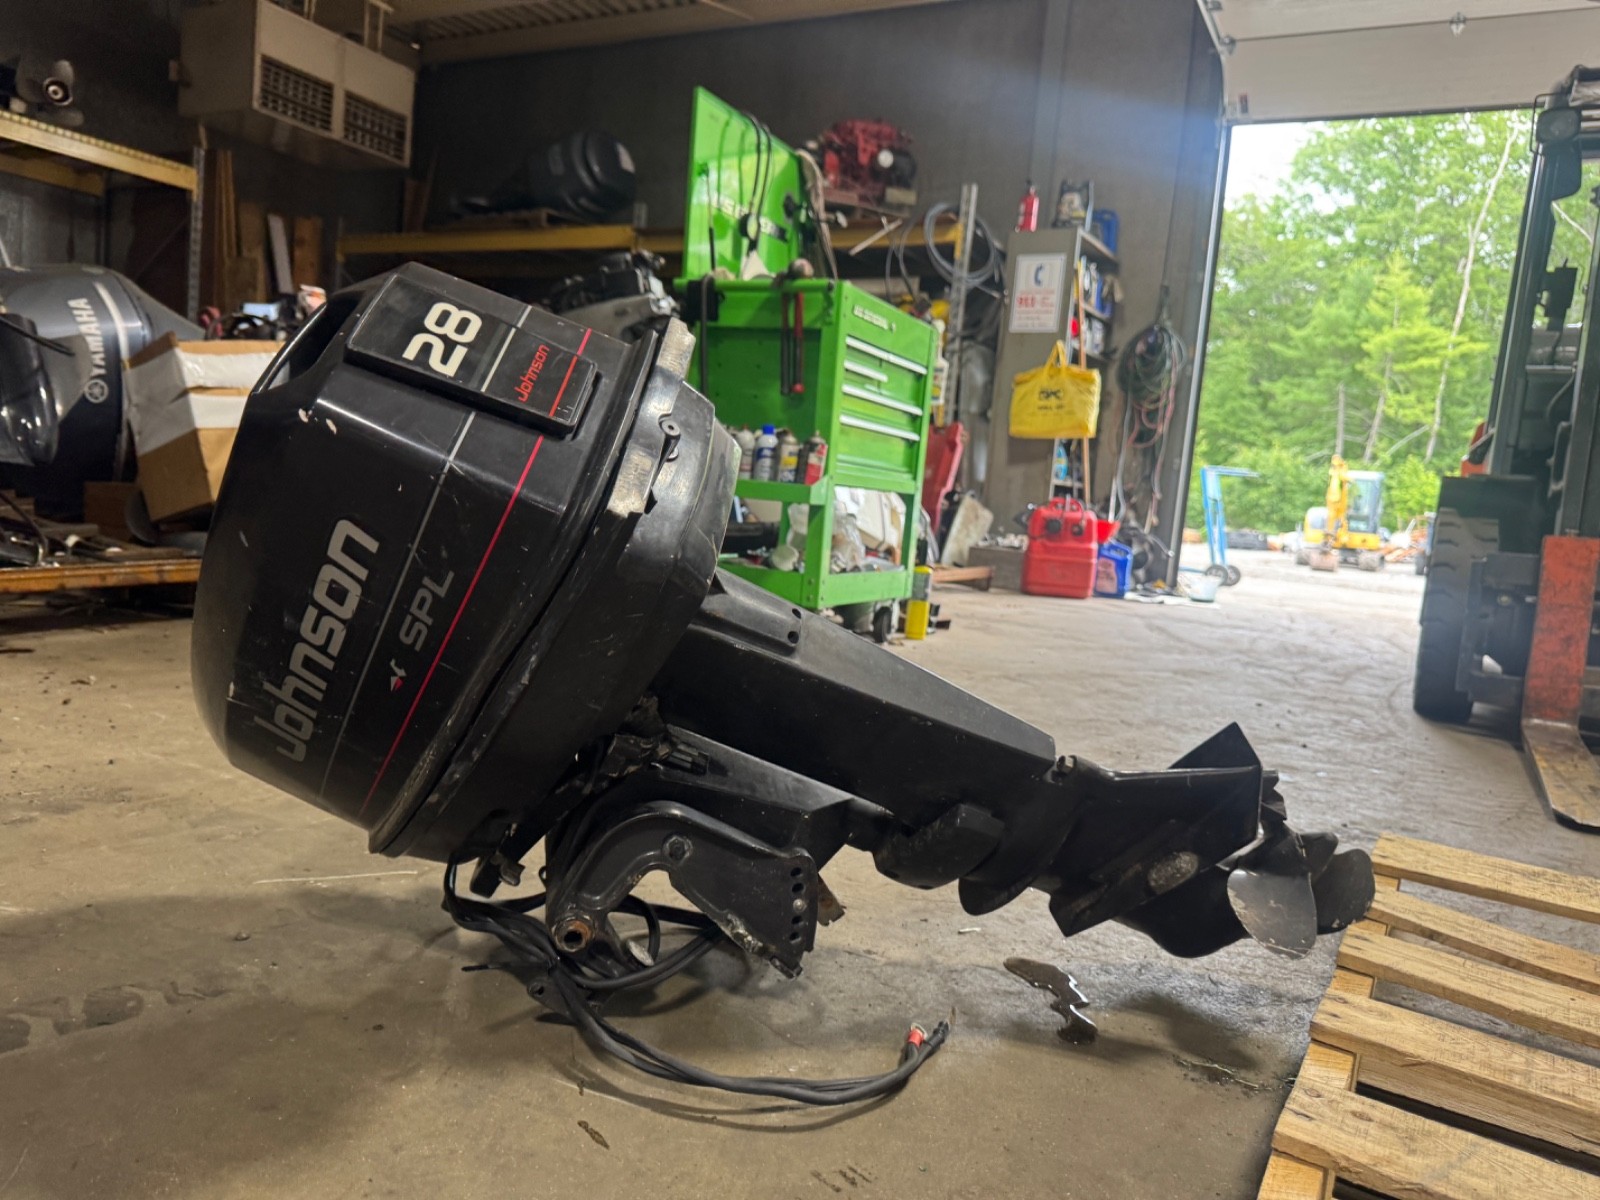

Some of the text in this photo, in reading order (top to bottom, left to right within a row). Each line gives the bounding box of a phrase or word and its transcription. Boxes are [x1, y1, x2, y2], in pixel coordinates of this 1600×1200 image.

[67, 297, 107, 377] YAMAHA
[404, 302, 482, 376] 28
[515, 344, 550, 402] Johnson
[255, 520, 379, 761] Johnson
[400, 569, 454, 651] SPL
